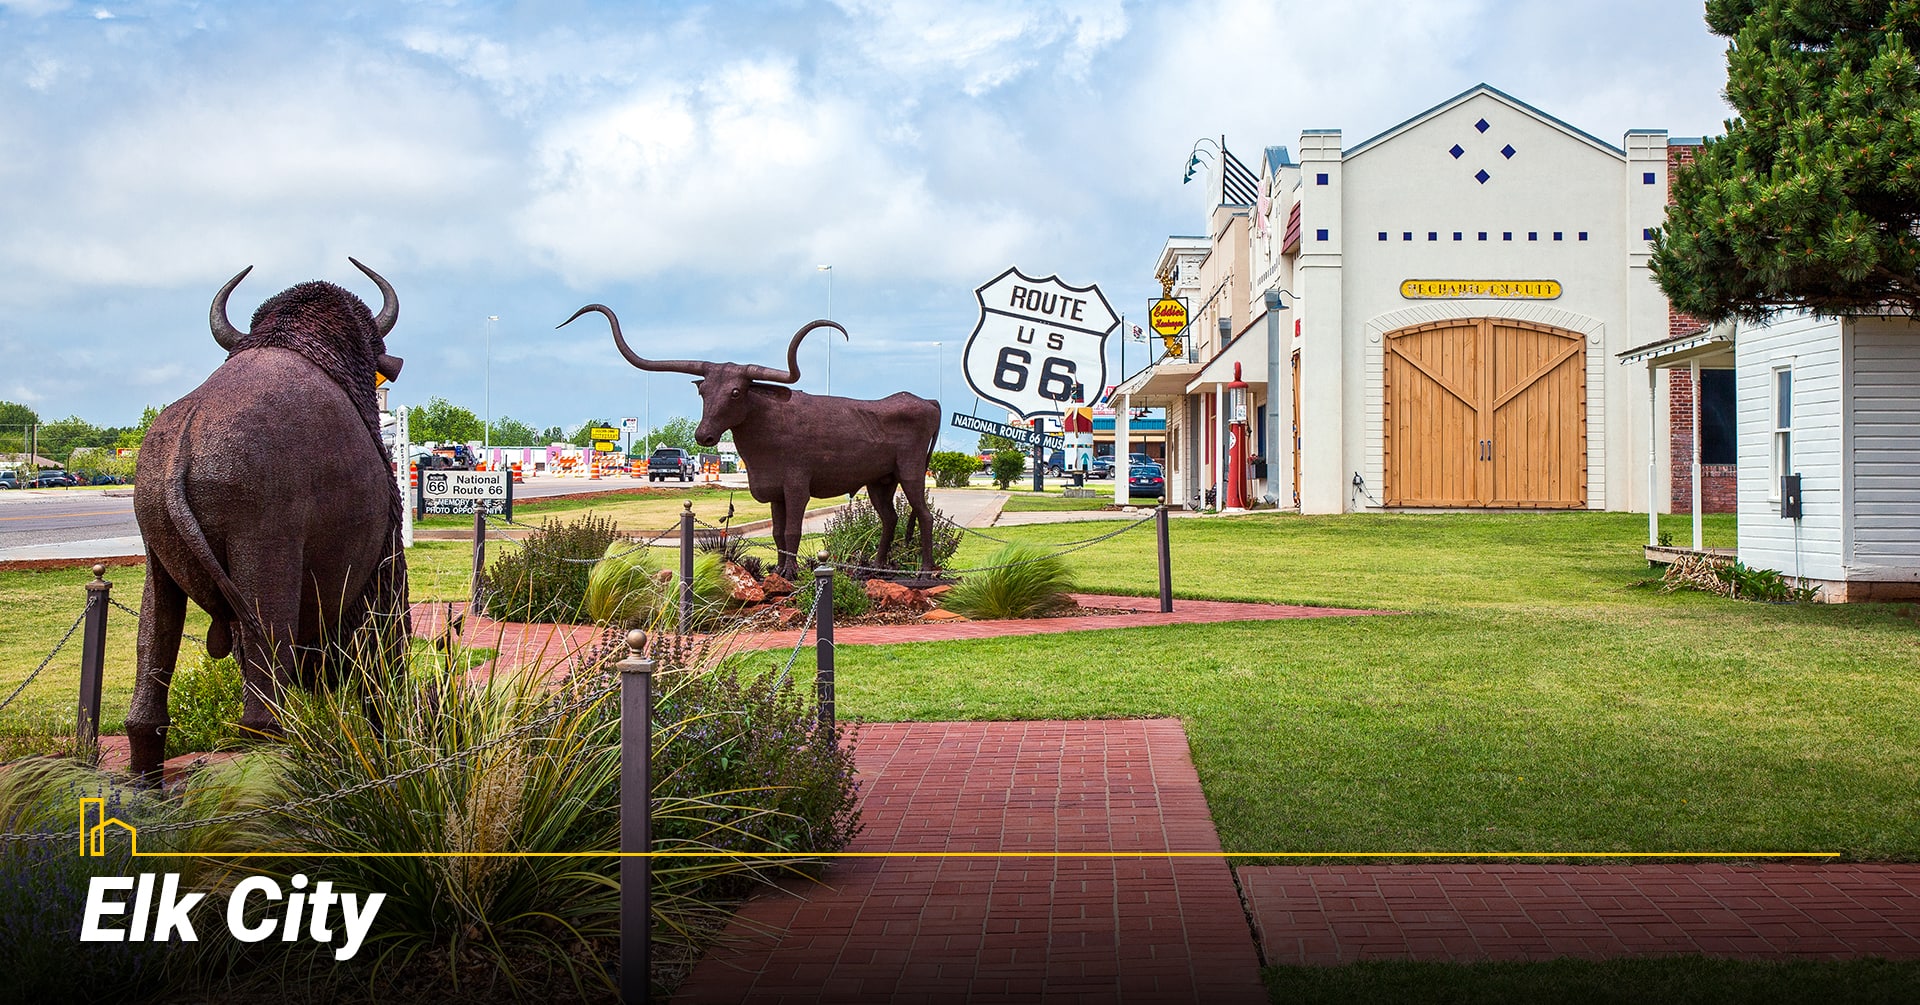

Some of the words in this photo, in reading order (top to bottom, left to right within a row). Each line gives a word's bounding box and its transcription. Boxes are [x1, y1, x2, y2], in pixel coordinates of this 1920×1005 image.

[1010, 285, 1087, 322] ROUTE
[993, 346, 1077, 402] 66
[954, 414, 997, 434] NATIONAL
[1000, 424, 1027, 441] ROUTE
[1029, 432, 1041, 444] 66
[456, 475, 500, 484] National
[429, 481, 445, 492] 66
[453, 485, 484, 495] Route
[488, 485, 503, 495] 66
[426, 506, 450, 514] PHOTO
[452, 506, 503, 514] OPPONITY
